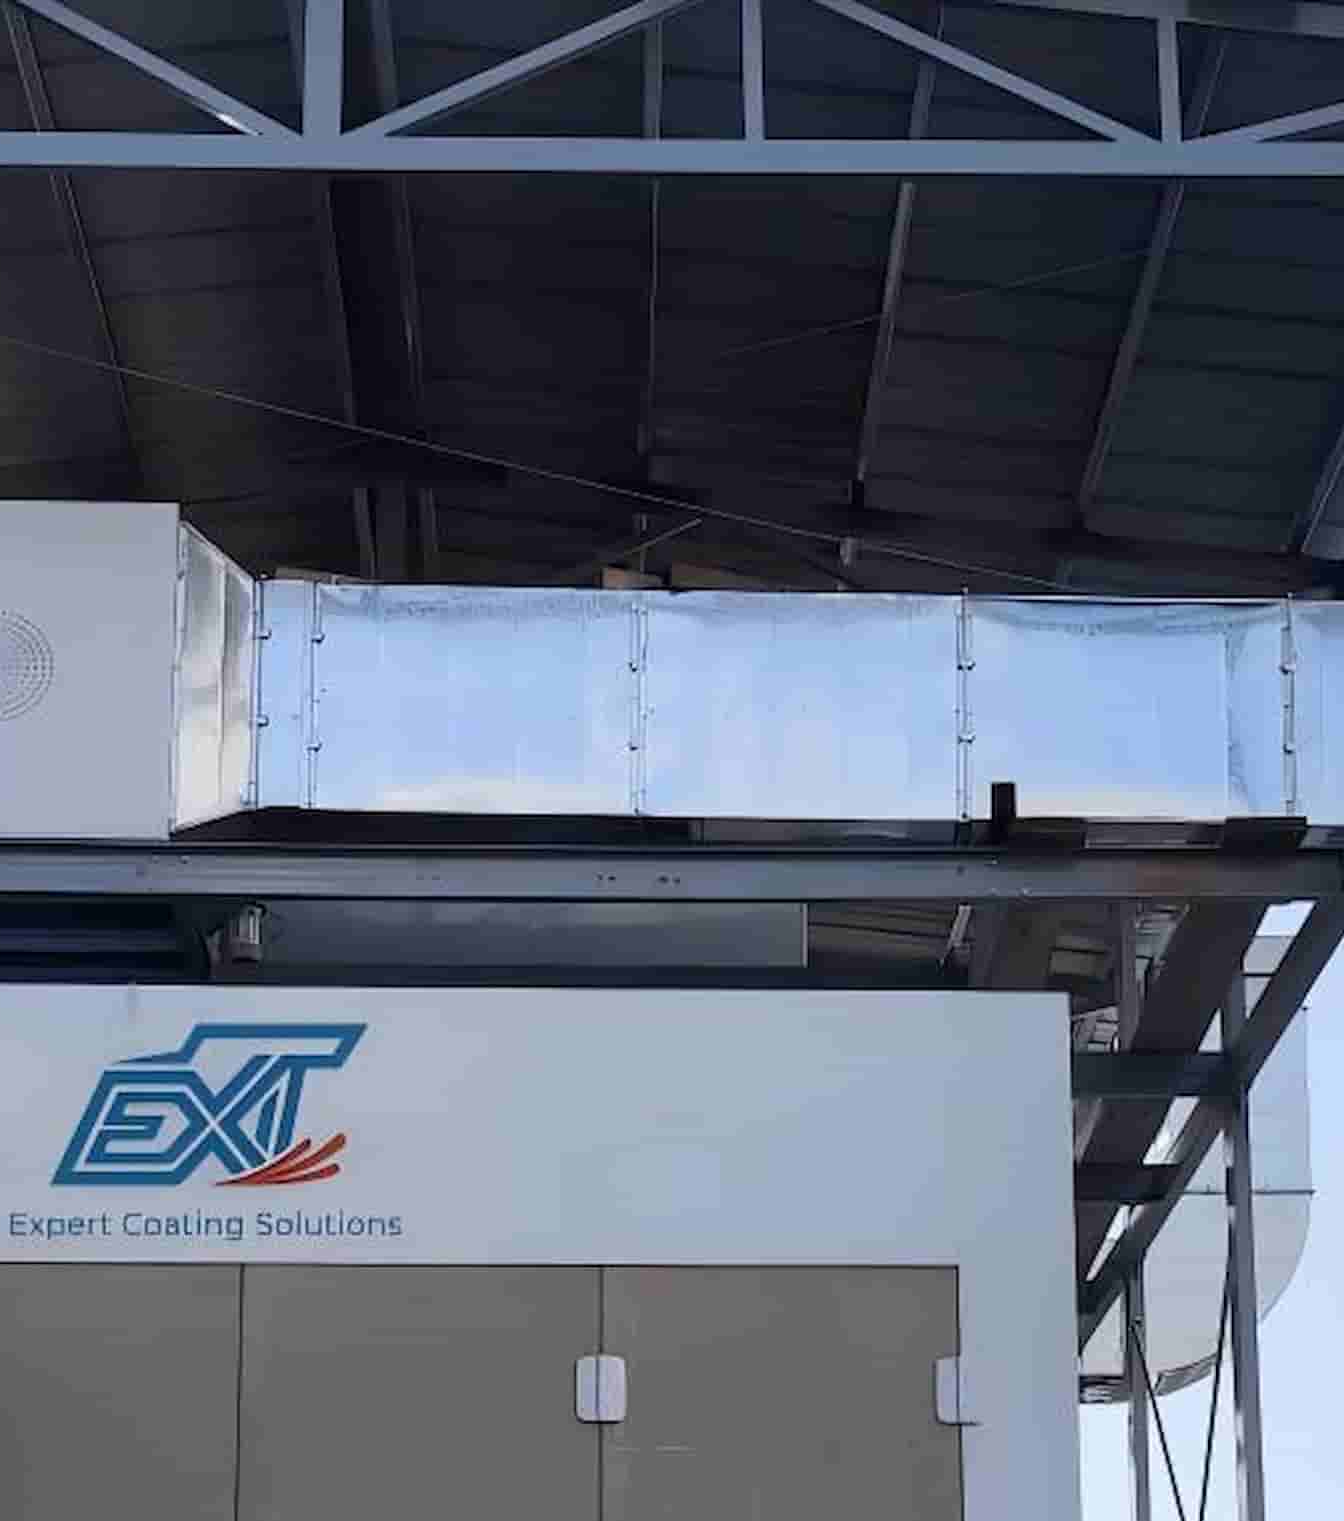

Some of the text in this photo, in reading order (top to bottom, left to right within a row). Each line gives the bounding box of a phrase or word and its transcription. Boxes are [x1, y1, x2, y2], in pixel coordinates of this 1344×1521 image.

[8, 1209, 404, 1241] Expert Coating Solutions
